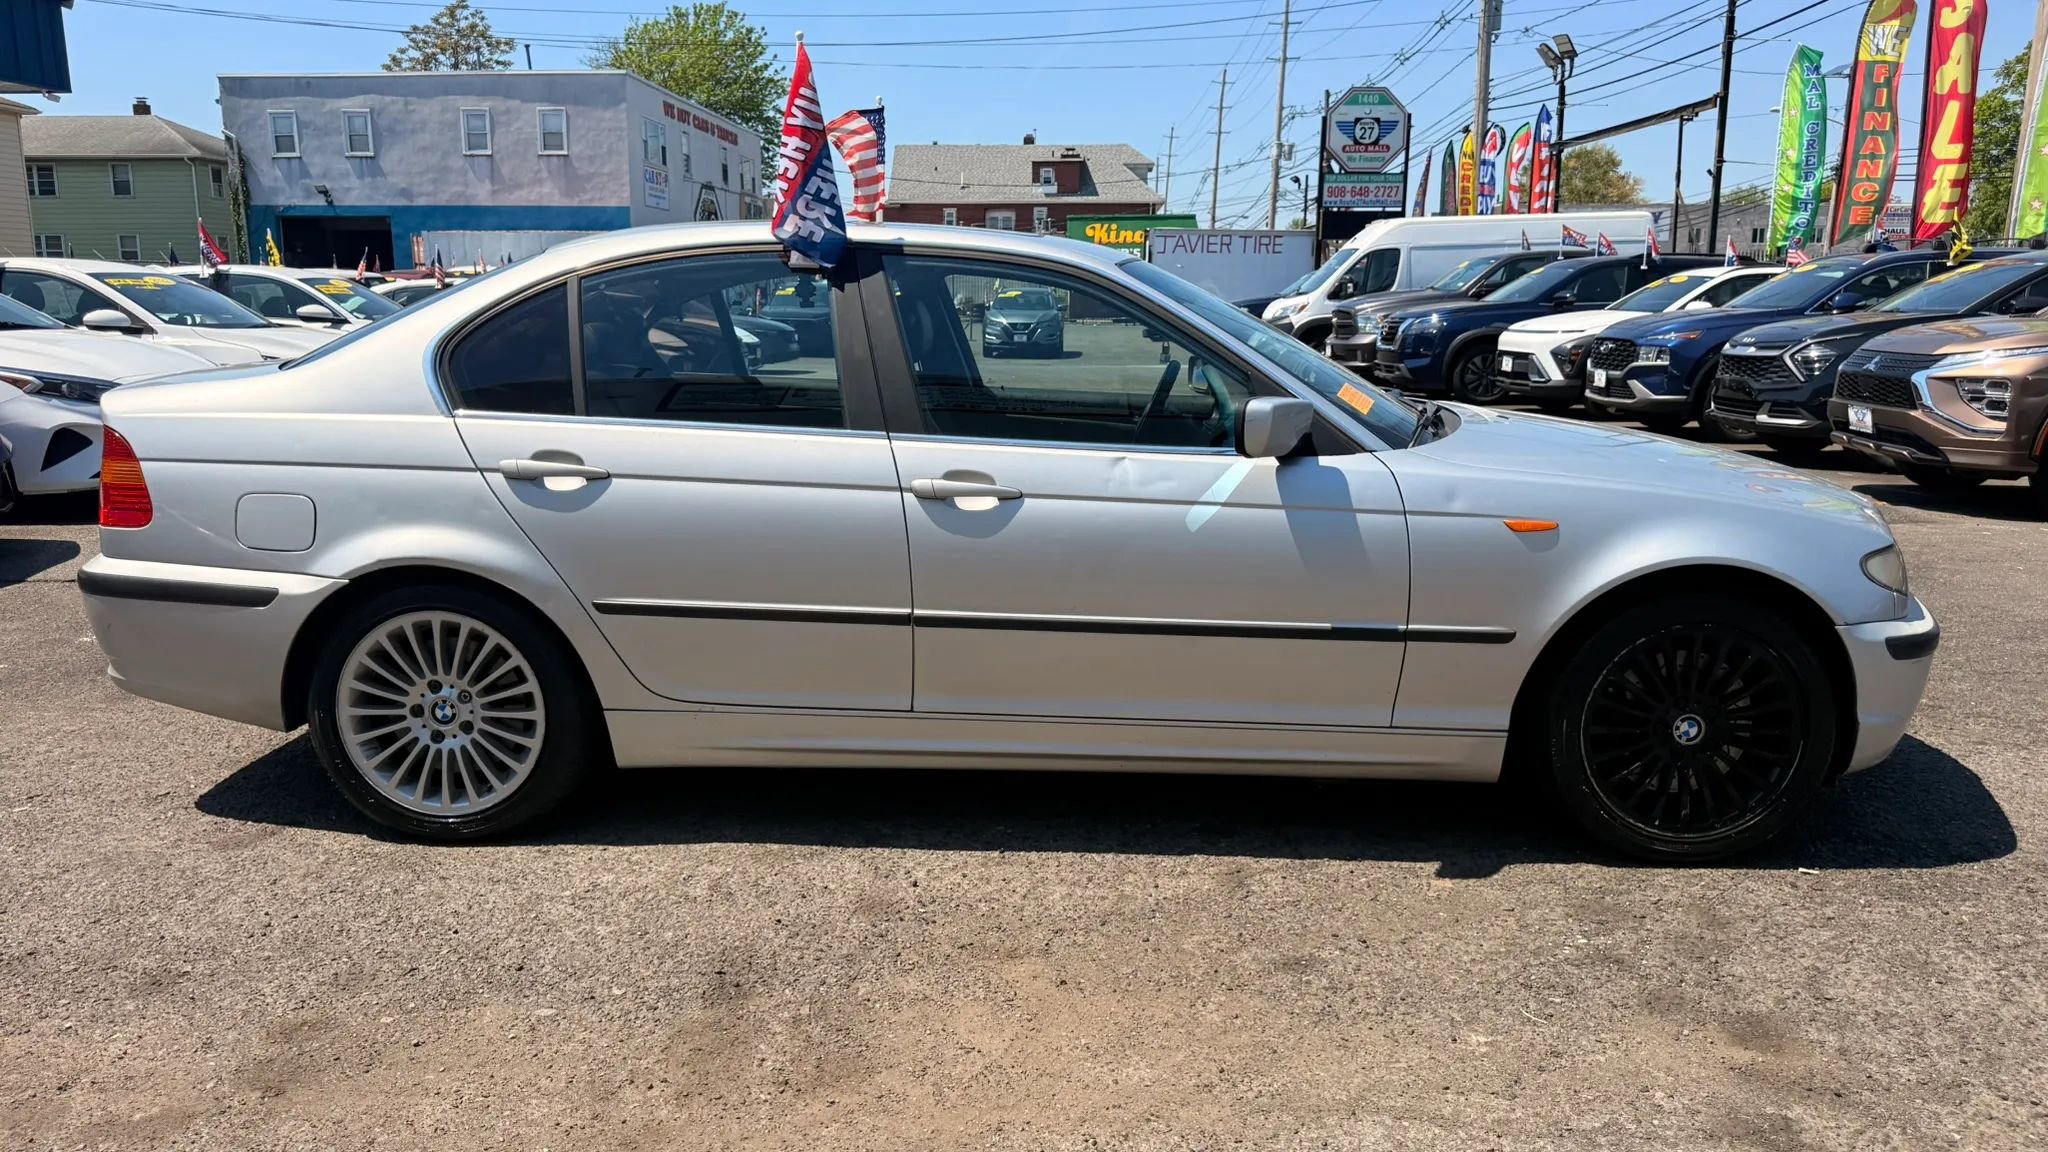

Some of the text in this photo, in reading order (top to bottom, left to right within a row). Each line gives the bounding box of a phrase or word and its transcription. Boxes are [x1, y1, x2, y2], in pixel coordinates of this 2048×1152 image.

[1868, 25, 1909, 56] WE
[1358, 94, 1379, 104] 1440
[1359, 126, 1375, 141] 27
[1794, 63, 1821, 230] MAL CREDITO
[1849, 64, 1890, 225] FINANCE
[1327, 186, 1400, 198] 908-648-2727
[1156, 234, 1283, 254] JAVIER TIRE
